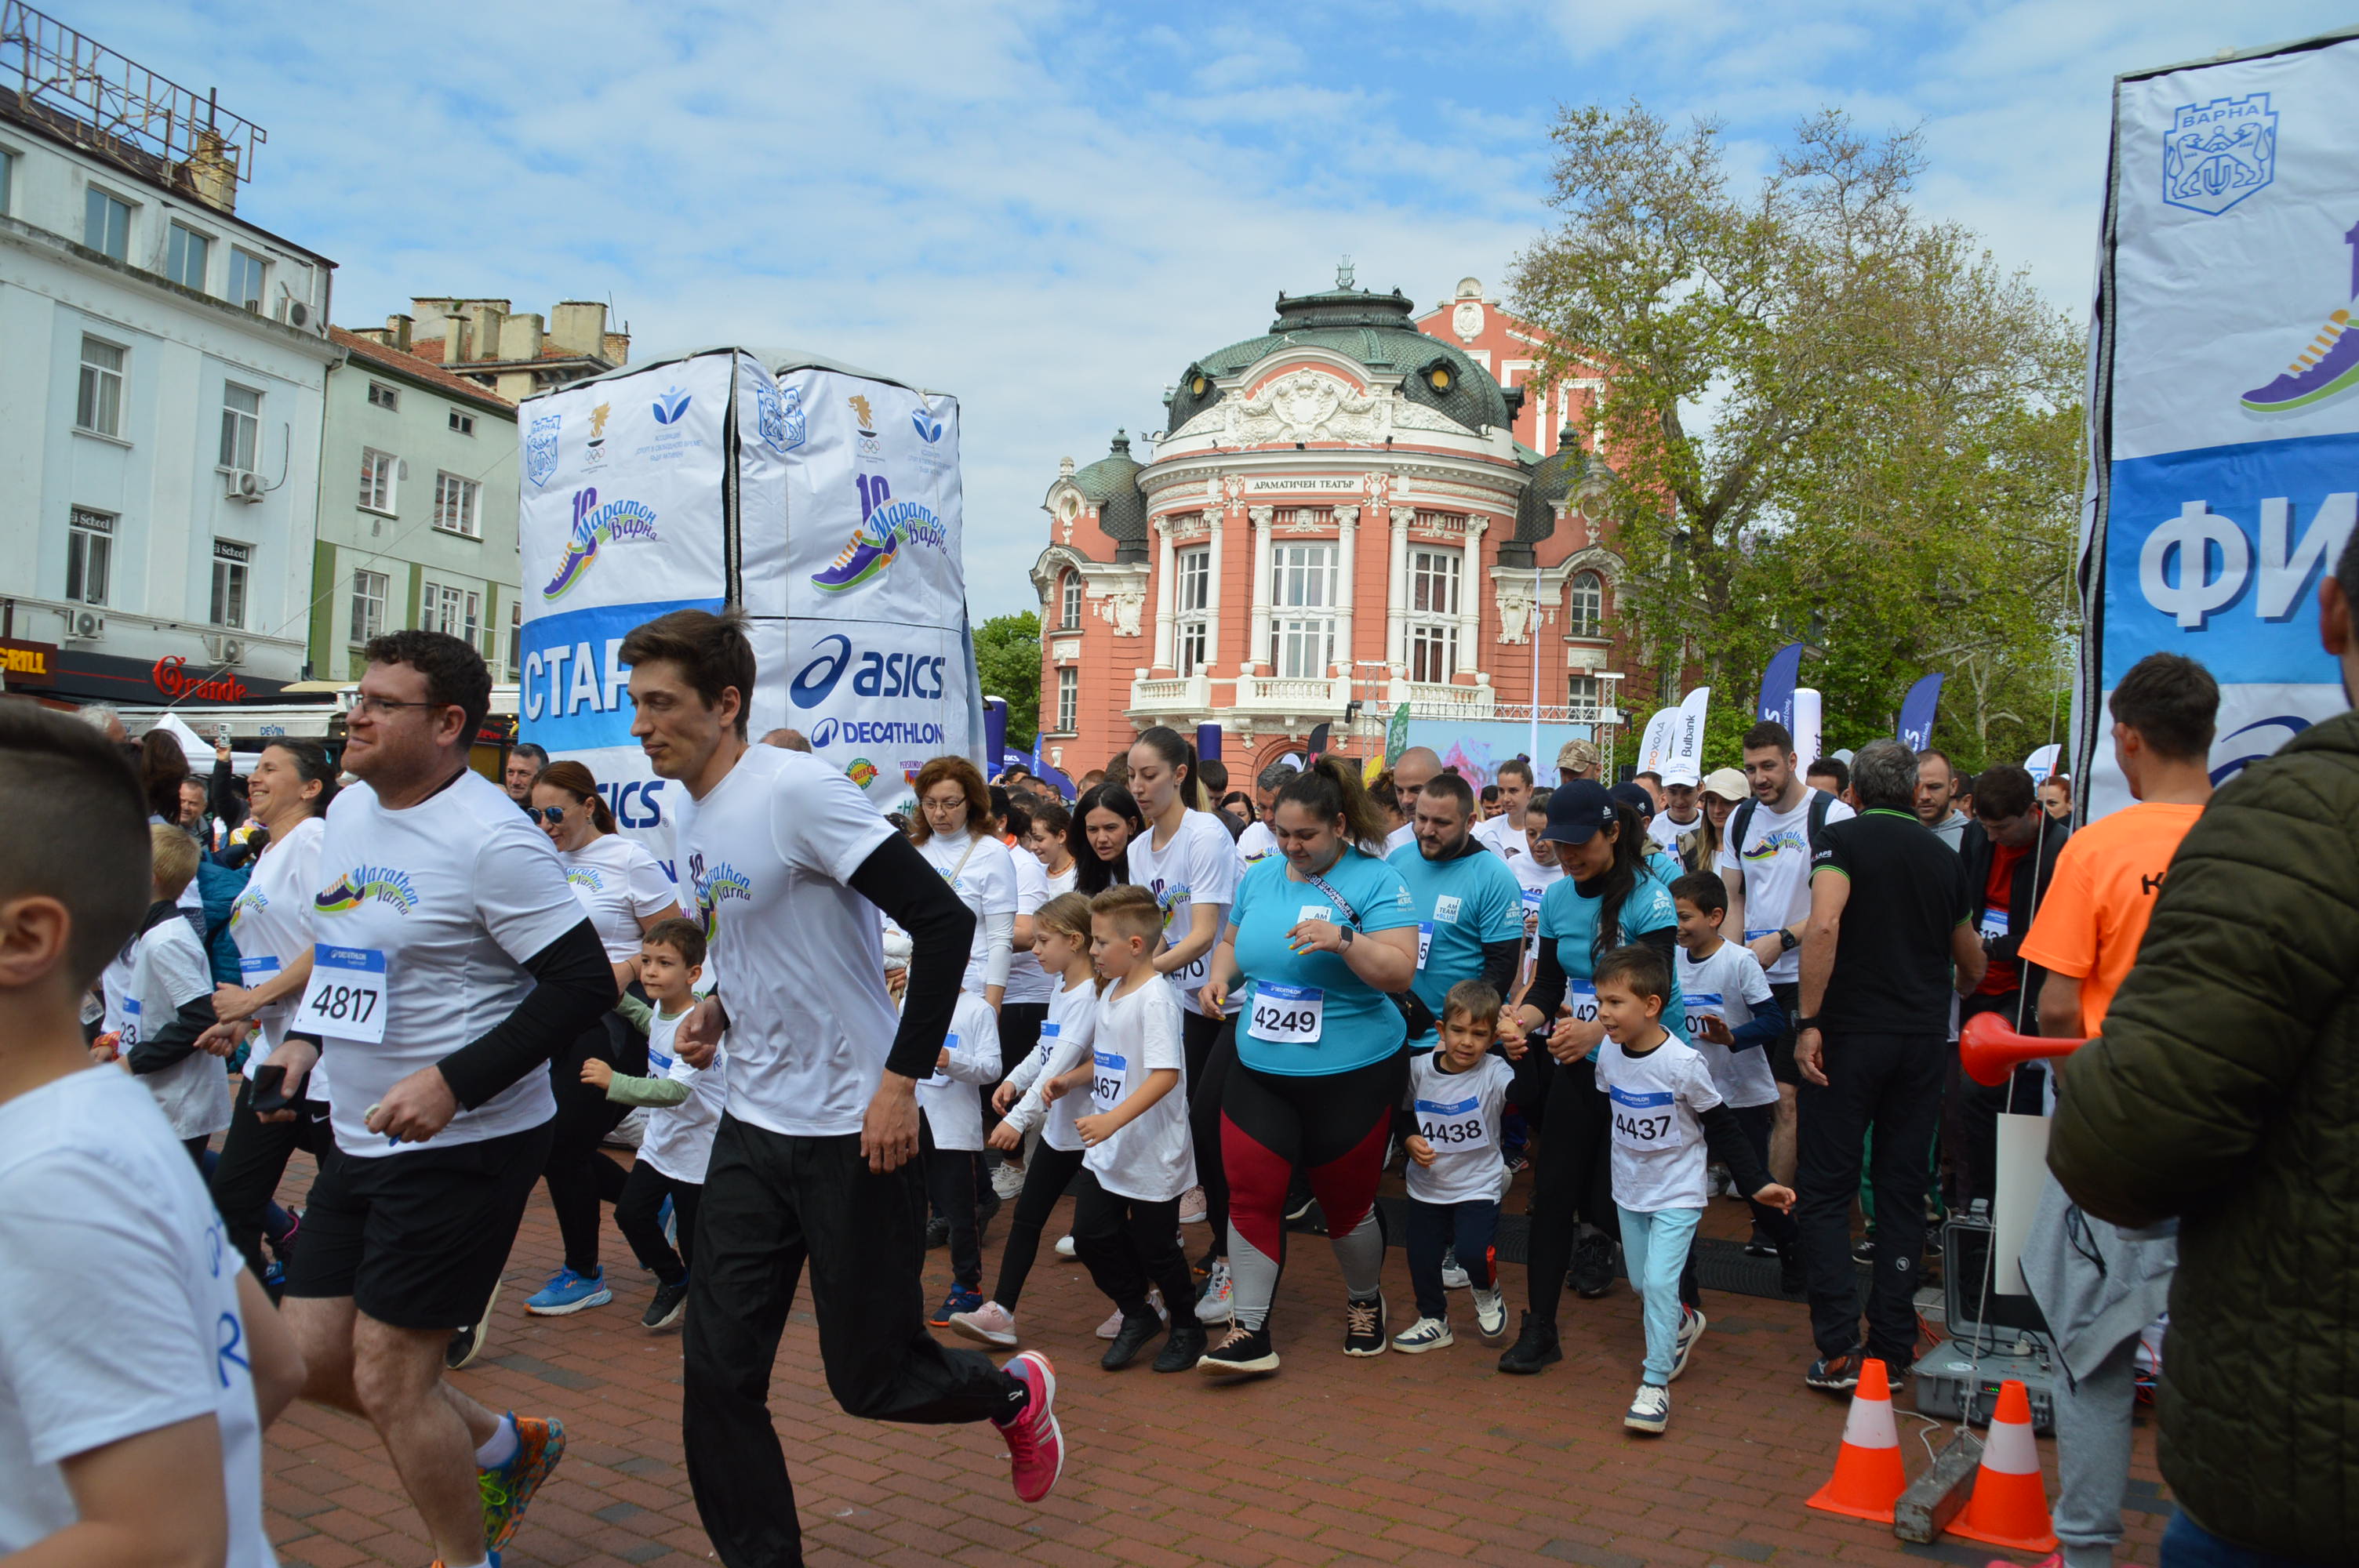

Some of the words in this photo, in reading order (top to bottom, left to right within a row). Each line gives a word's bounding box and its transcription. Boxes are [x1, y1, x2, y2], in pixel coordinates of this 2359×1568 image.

[2183, 103, 2259, 129] ВАРНА
[1253, 480, 1316, 490] ДРАМАТИЧЕН
[1320, 480, 1354, 489] ТЕАТЪР
[572, 487, 597, 539] 10
[856, 473, 891, 528] 10
[80, 514, 109, 529] School
[608, 517, 658, 542] Варна
[222, 545, 246, 560] School
[260, 724, 285, 735] DEVIN
[842, 721, 945, 744] DECATHLON
[1681, 714, 1696, 757] Bulbank
[353, 863, 419, 906] Marathon
[376, 884, 409, 916] Varna
[1439, 907, 1456, 916] TEAM
[311, 984, 378, 1023] 4817
[1255, 1006, 1316, 1033] 4249
[1422, 1120, 1482, 1144] 4438
[1616, 1113, 1671, 1141] 4437
